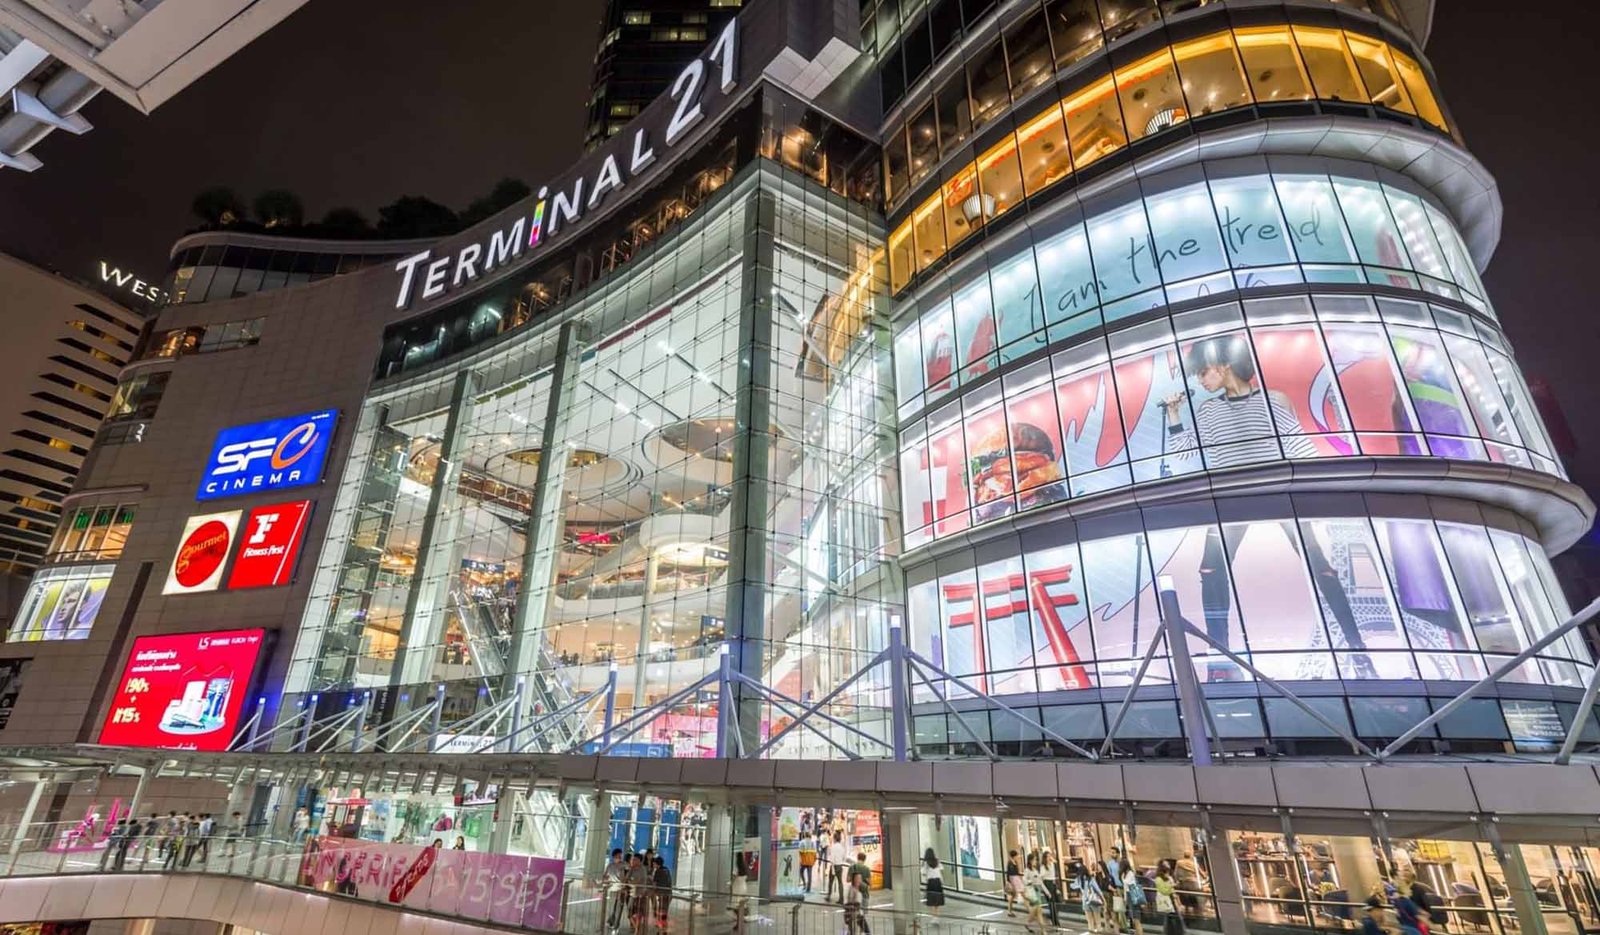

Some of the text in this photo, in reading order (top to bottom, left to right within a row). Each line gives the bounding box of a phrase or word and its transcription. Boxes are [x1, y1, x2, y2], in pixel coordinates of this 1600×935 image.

[666, 17, 738, 146] 21
[1058, 277, 1106, 313] am
[1127, 234, 1200, 284] the
[1221, 203, 1325, 254] trend
[206, 470, 301, 493] CINEMA
[249, 513, 279, 544] F
[493, 872, 558, 913] SEP
